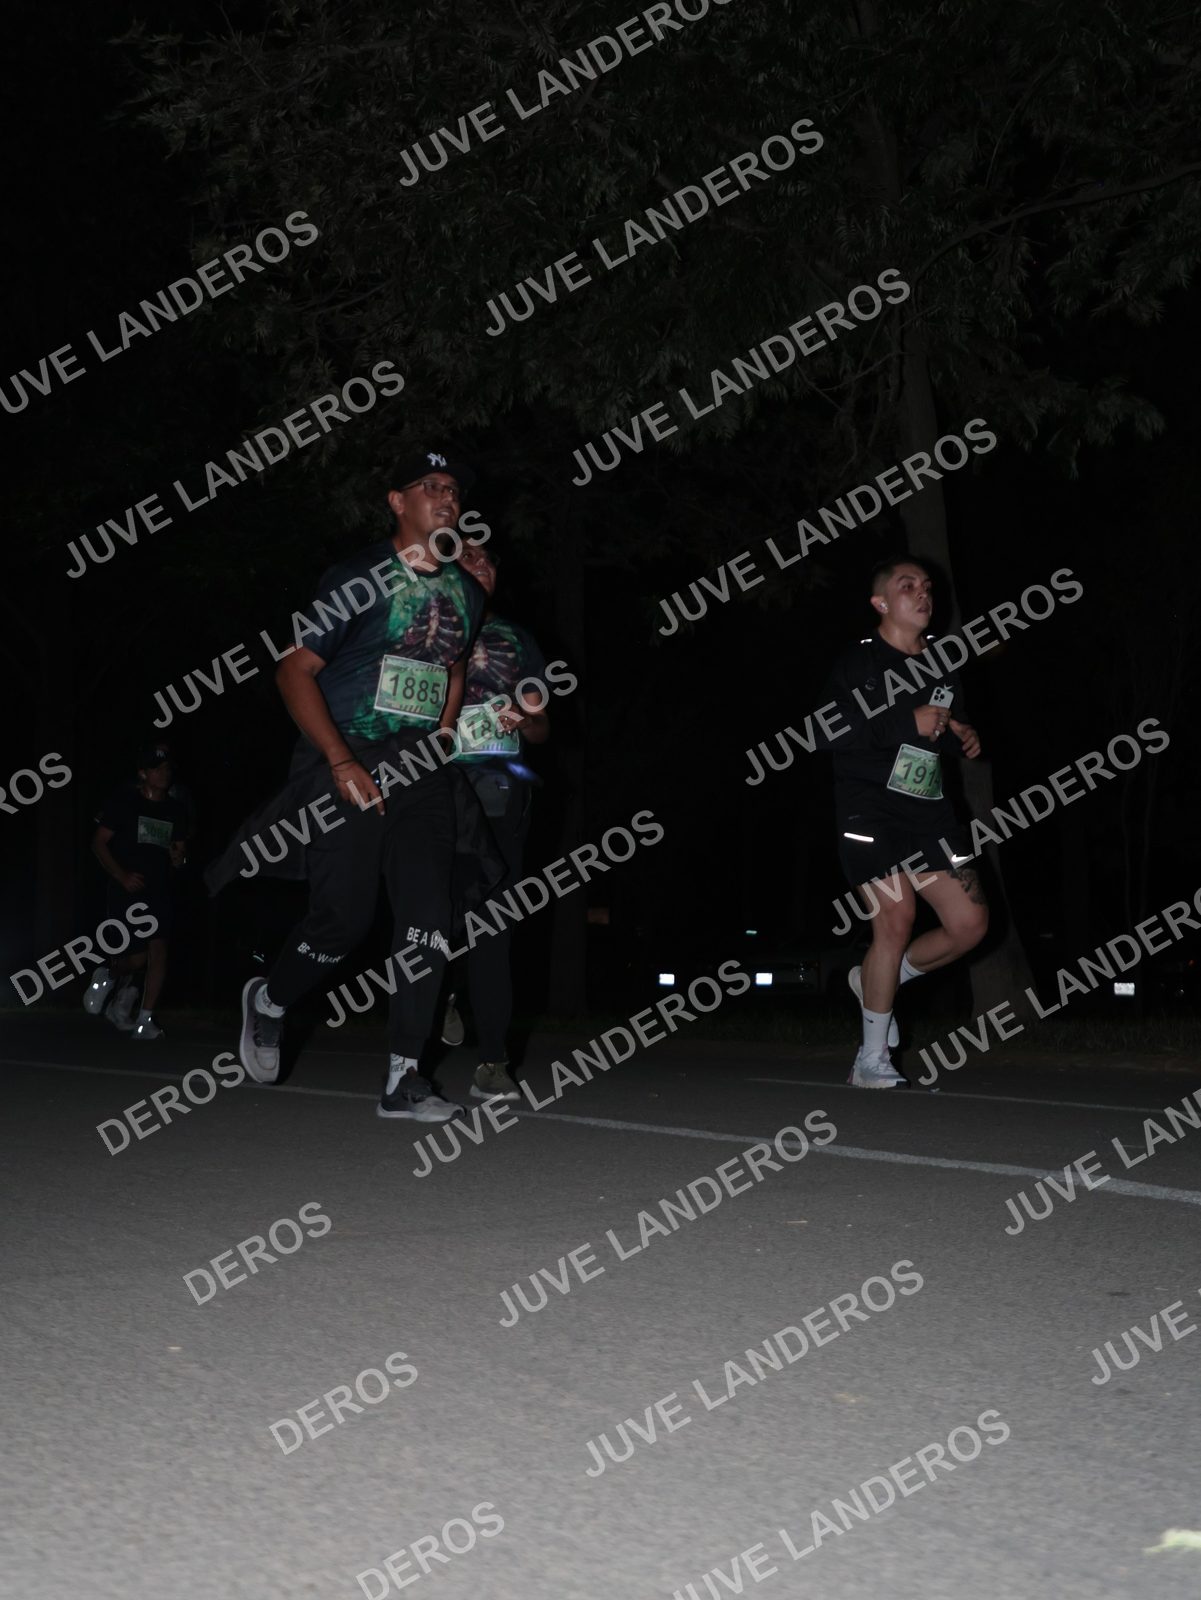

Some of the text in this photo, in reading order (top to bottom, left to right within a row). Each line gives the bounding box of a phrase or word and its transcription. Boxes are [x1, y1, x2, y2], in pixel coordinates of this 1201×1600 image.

[389, 673, 440, 705] 1885
[406, 926, 421, 943] BE
[420, 931, 428, 946] A
